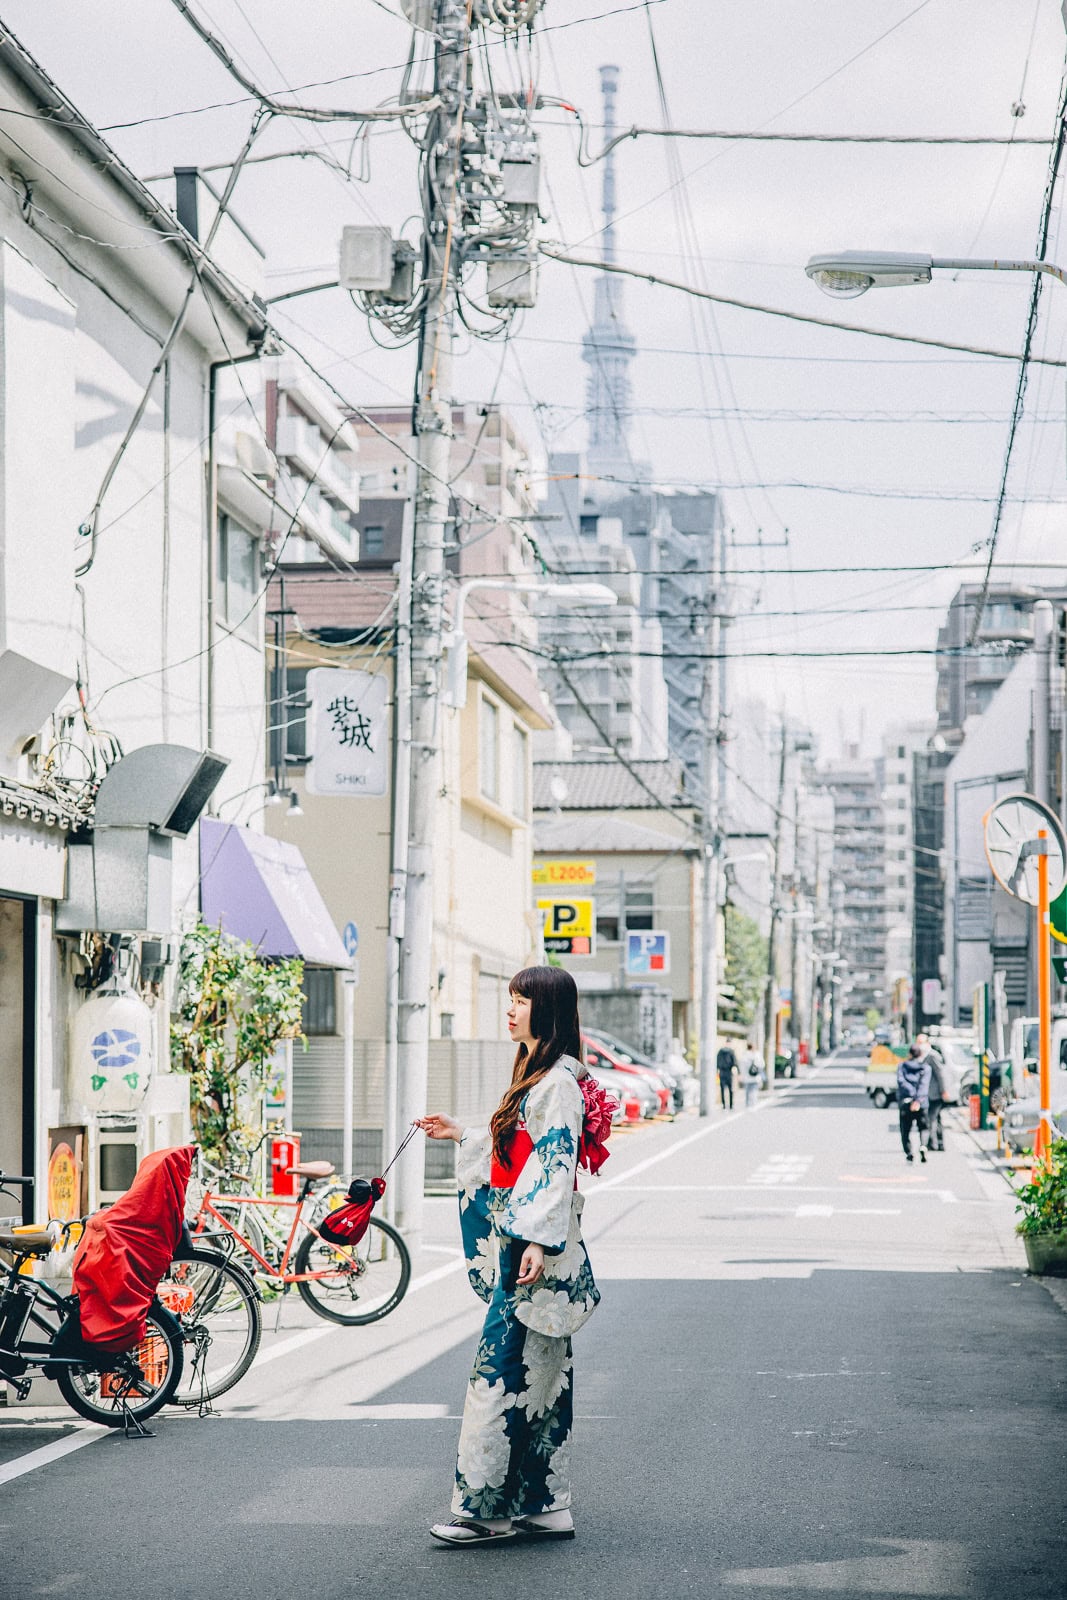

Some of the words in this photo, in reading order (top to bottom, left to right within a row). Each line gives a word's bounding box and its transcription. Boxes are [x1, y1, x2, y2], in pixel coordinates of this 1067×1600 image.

[326, 696, 375, 753] 紫城
[335, 773, 367, 785] SHIKI
[553, 904, 577, 931] P
[640, 936, 657, 954] P
